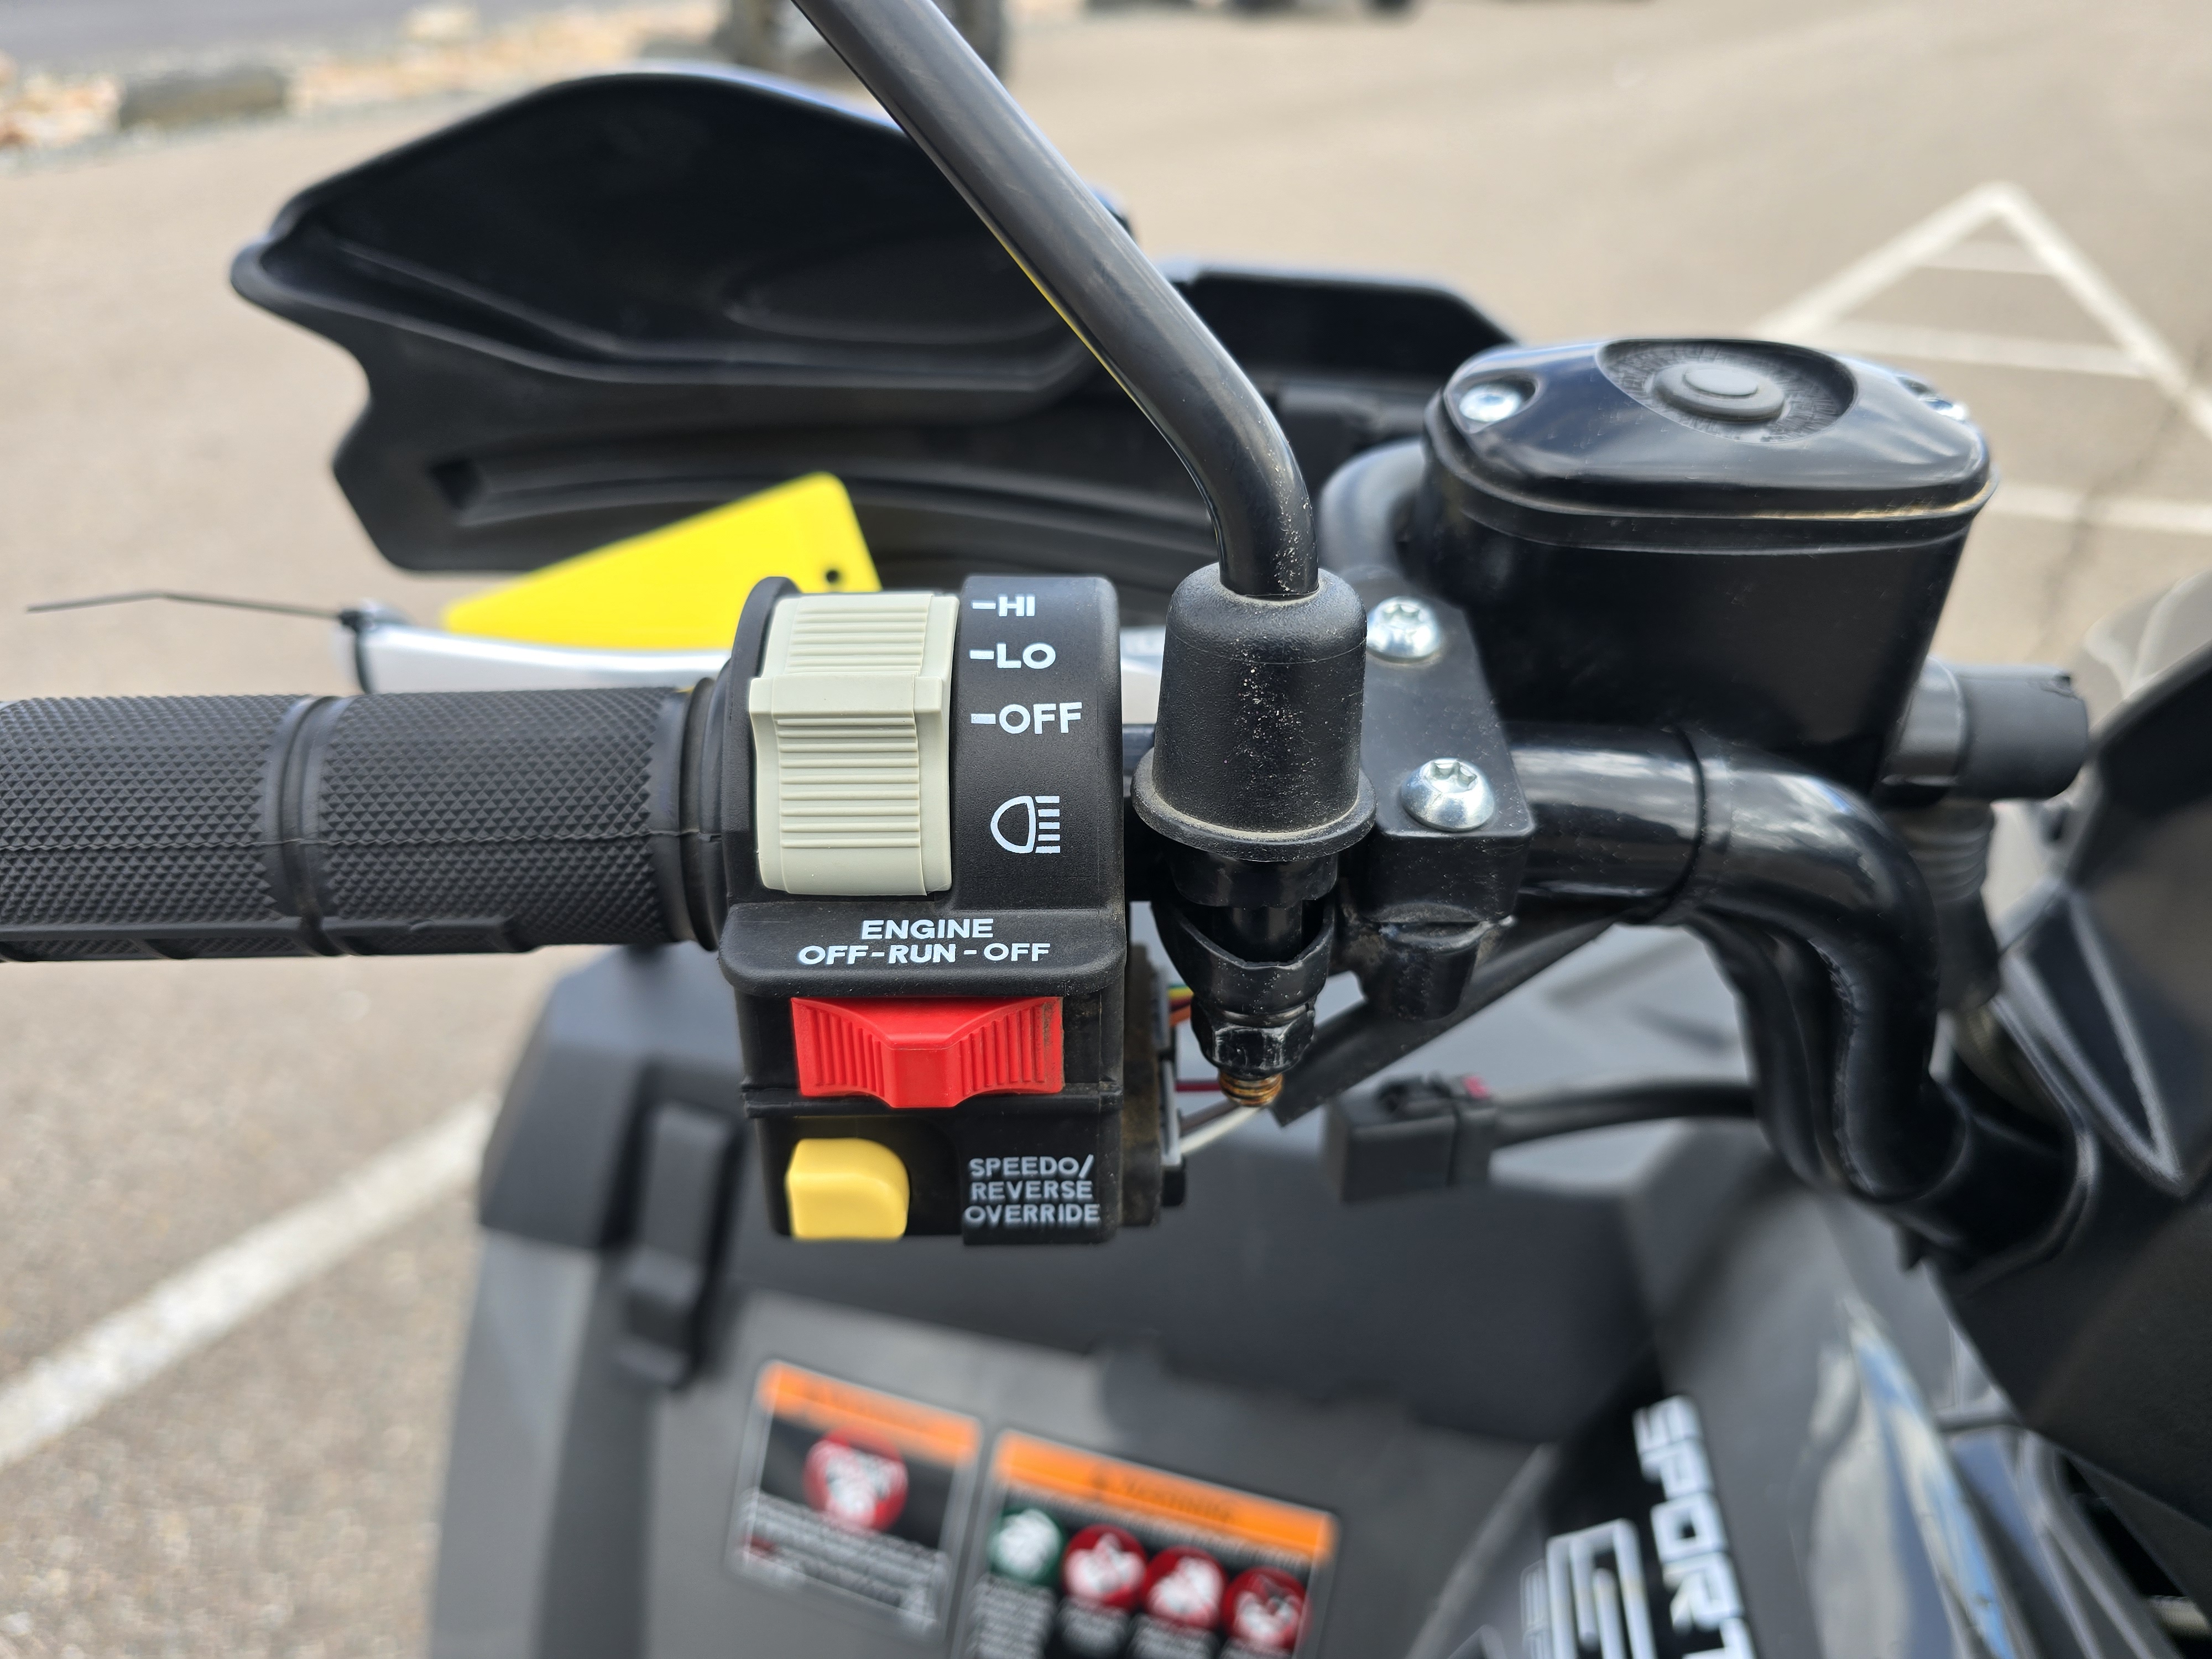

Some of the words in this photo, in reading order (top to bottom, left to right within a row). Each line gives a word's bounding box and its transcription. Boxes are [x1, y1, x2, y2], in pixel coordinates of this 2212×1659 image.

[859, 918, 994, 941] ENGINE
[969, 1154, 1094, 1179] SPEEDO/
[970, 1180, 1093, 1202] REVERSE
[964, 1203, 1100, 1225] OVERRIDE
